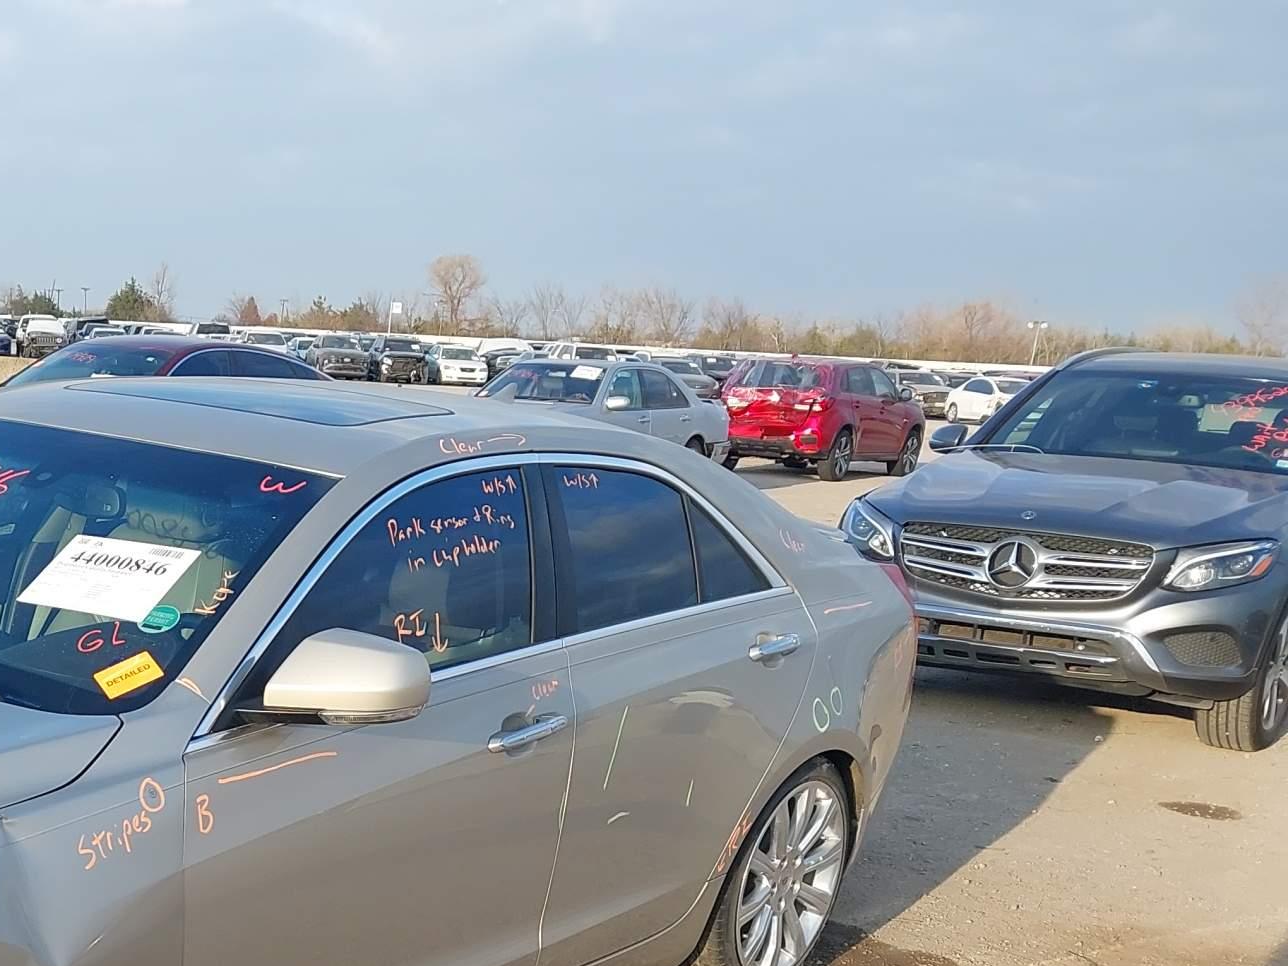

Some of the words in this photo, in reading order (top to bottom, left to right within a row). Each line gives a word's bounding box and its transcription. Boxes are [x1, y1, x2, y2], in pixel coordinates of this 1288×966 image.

[387, 517, 426, 547] Park
[430, 514, 469, 534] sensor
[71, 550, 169, 577] 44000846
[408, 550, 425, 573] in
[106, 663, 151, 688] DETAILED
